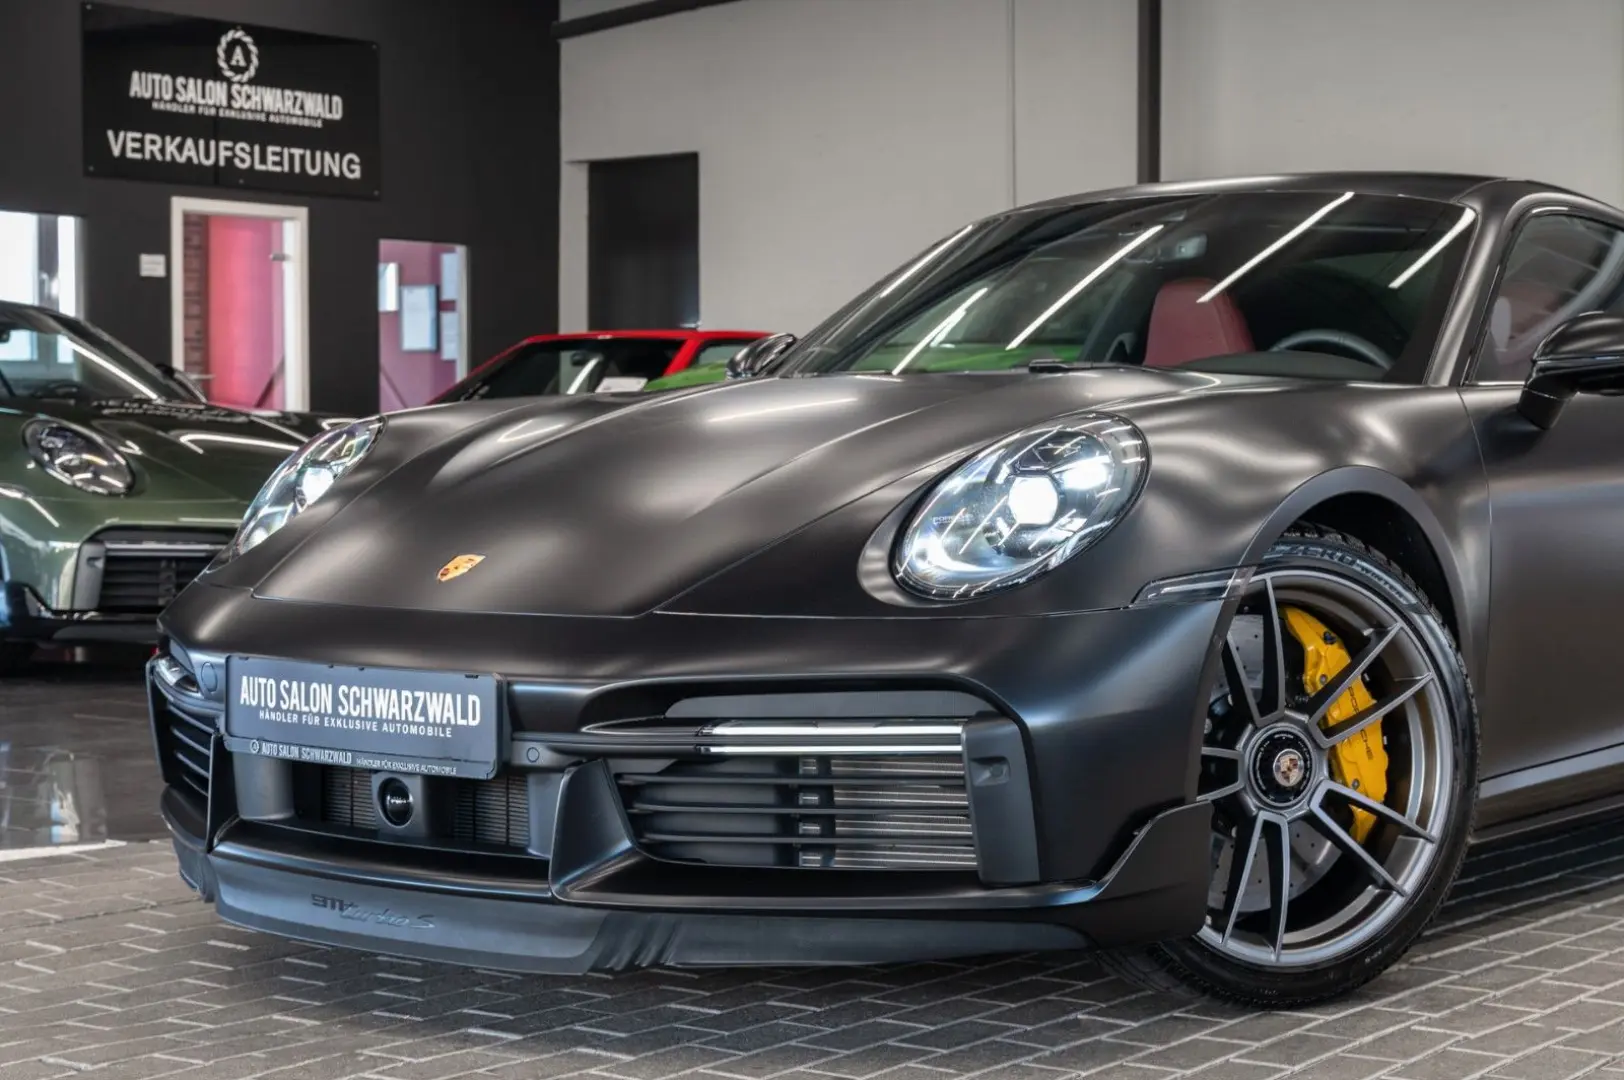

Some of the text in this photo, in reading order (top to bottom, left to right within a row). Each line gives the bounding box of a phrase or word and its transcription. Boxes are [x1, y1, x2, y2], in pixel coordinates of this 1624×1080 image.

[229, 45, 247, 67] A
[129, 71, 343, 121] AUTO SALON SCHWARZWALD
[106, 129, 362, 180] VERKAUFSLEITUNG
[239, 675, 481, 727] AUTO SALON SCHWARZWALD
[259, 708, 452, 738] HÄNDLER FÜR EXKLUSIVE AUTOMOBILE
[1347, 685, 1374, 761] PORCHE
[261, 742, 278, 755] AUTO
[278, 744, 300, 759] SALON
[301, 747, 352, 765] SCHWARZWALD
[410, 913, 436, 929] S
